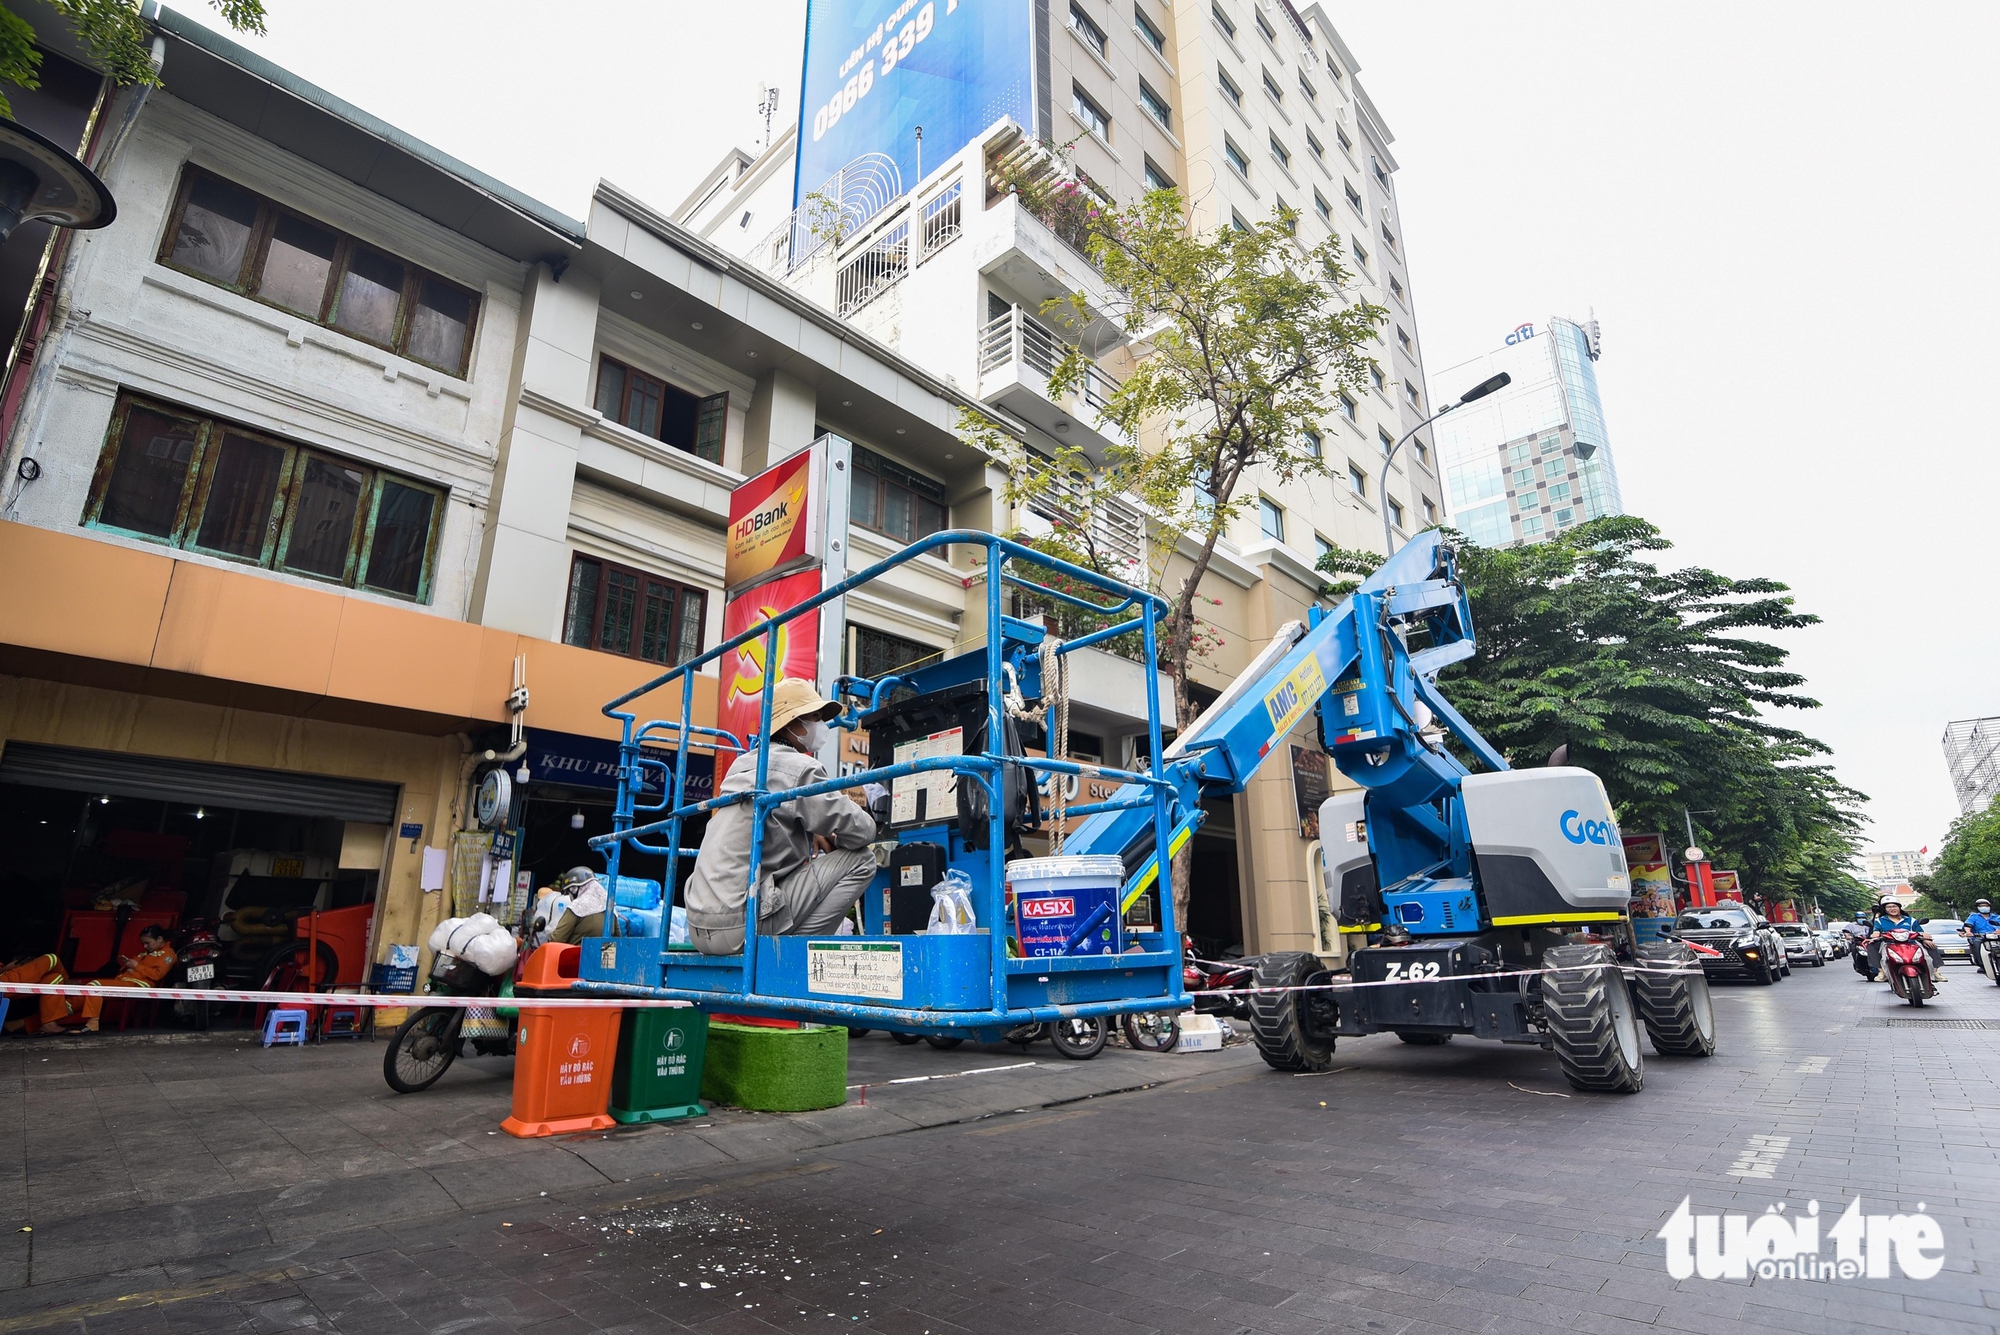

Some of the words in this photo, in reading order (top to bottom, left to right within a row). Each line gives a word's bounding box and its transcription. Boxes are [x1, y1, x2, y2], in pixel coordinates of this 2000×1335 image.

[813, 59, 874, 142] 0966
[881, 1, 935, 77] 339
[1505, 324, 1535, 346] citi
[736, 502, 788, 541] HDBank
[1269, 681, 1298, 725] AMC
[540, 754, 591, 774] KHU
[592, 761, 621, 778] PH
[685, 773, 713, 790] HÓ
[1023, 901, 1071, 916] KASIX
[892, 955, 899, 964] kg
[827, 970, 850, 979] Occupants
[860, 973, 885, 982] equipment
[1385, 961, 1440, 982] Z-62
[851, 982, 860, 990] 500
[882, 984, 889, 993] kg
[668, 1053, 676, 1064] BỎ
[676, 1054, 687, 1064] RÁC
[572, 1060, 582, 1072] BỎ
[582, 1062, 594, 1072] RÁC
[657, 1066, 668, 1077] VÀO
[668, 1066, 685, 1076] THÙNG
[560, 1074, 572, 1086] VÀO
[573, 1074, 592, 1084] THÙNG
